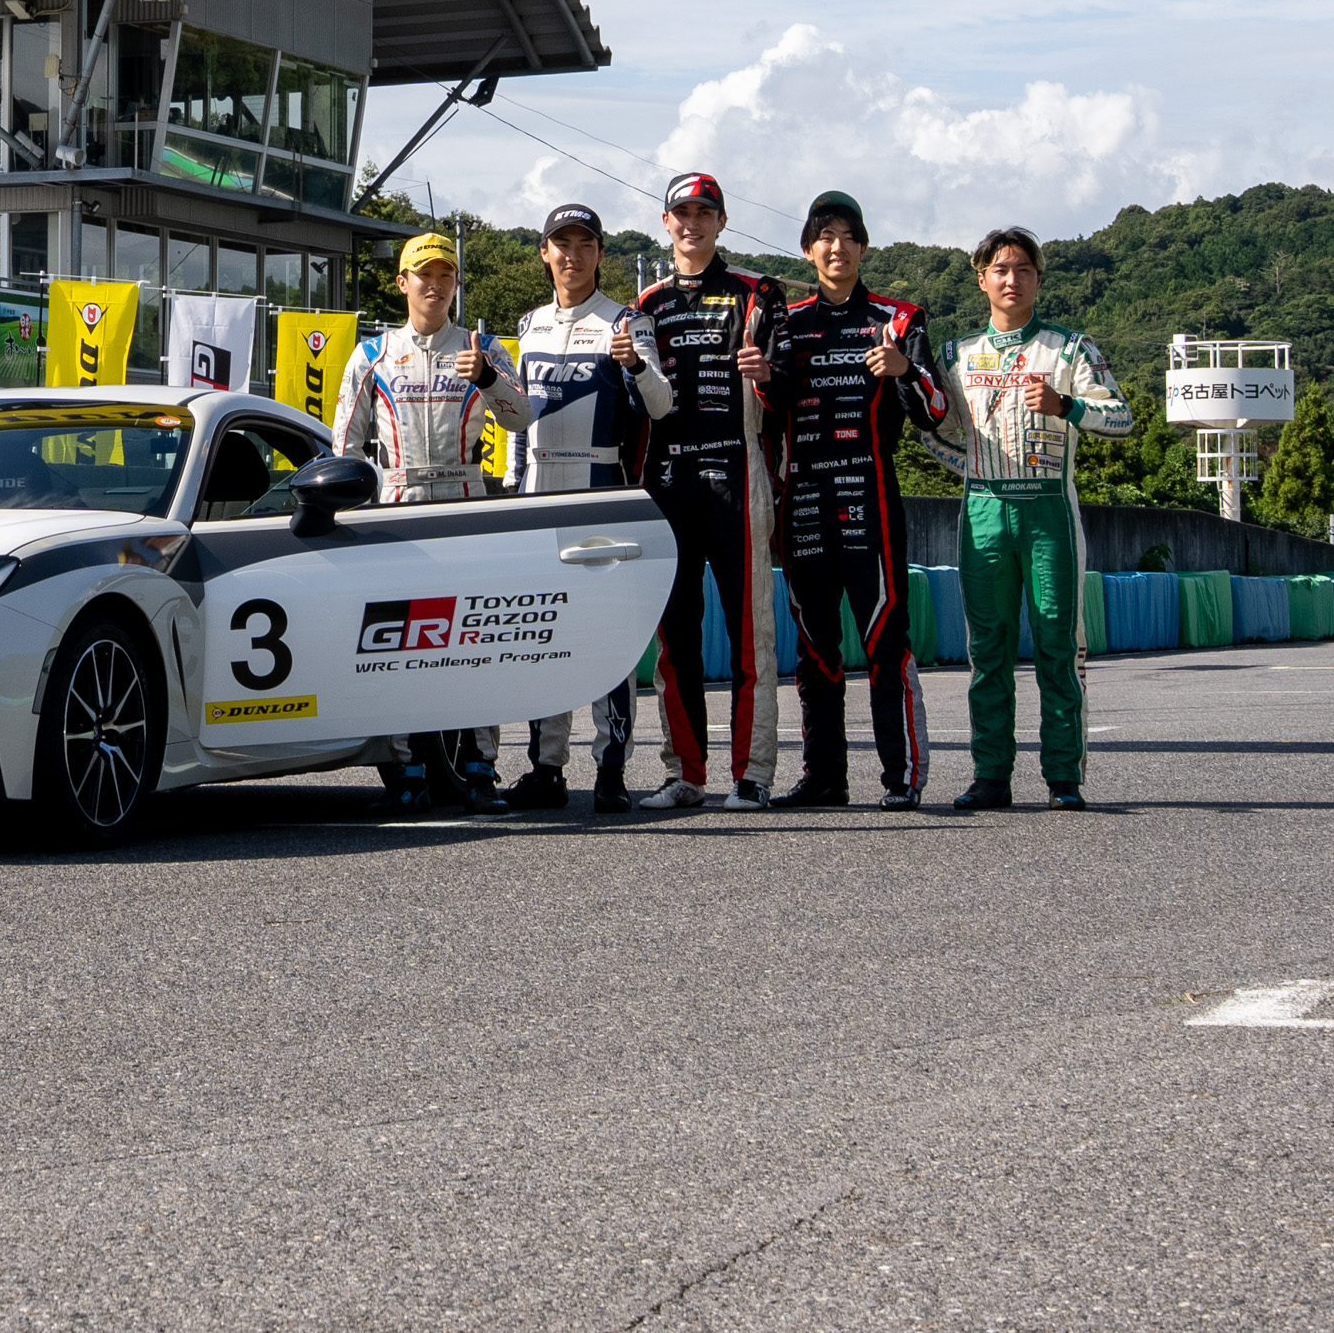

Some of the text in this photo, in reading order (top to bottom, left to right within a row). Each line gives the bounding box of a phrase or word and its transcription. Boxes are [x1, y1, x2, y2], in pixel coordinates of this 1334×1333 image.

[554, 209, 592, 222] KTMS
[669, 333, 723, 348] CUSCO
[810, 353, 867, 366] CUSCO
[527, 360, 597, 383] KTMS
[698, 370, 731, 379] BRIDE
[430, 374, 467, 393] Blue
[809, 375, 866, 388] YOKOHAMA
[970, 373, 1047, 386] TONY KAT
[1181, 382, 1291, 400] 名古屋トヨペット
[835, 411, 863, 419] BRIDE
[836, 429, 858, 439] TONE
[700, 441, 723, 451] JONES
[811, 454, 874, 470] HIROYA.M RH+A
[1038, 459, 1061, 468] Shell
[793, 546, 824, 557] LEGION
[464, 591, 569, 611] TOYOTA
[461, 609, 558, 628] GAZOO
[360, 617, 451, 651] GR
[458, 627, 554, 646] Racing
[229, 597, 293, 691] 3
[355, 649, 572, 674] WRC Challenge Program
[227, 701, 310, 718] DUNLOP
